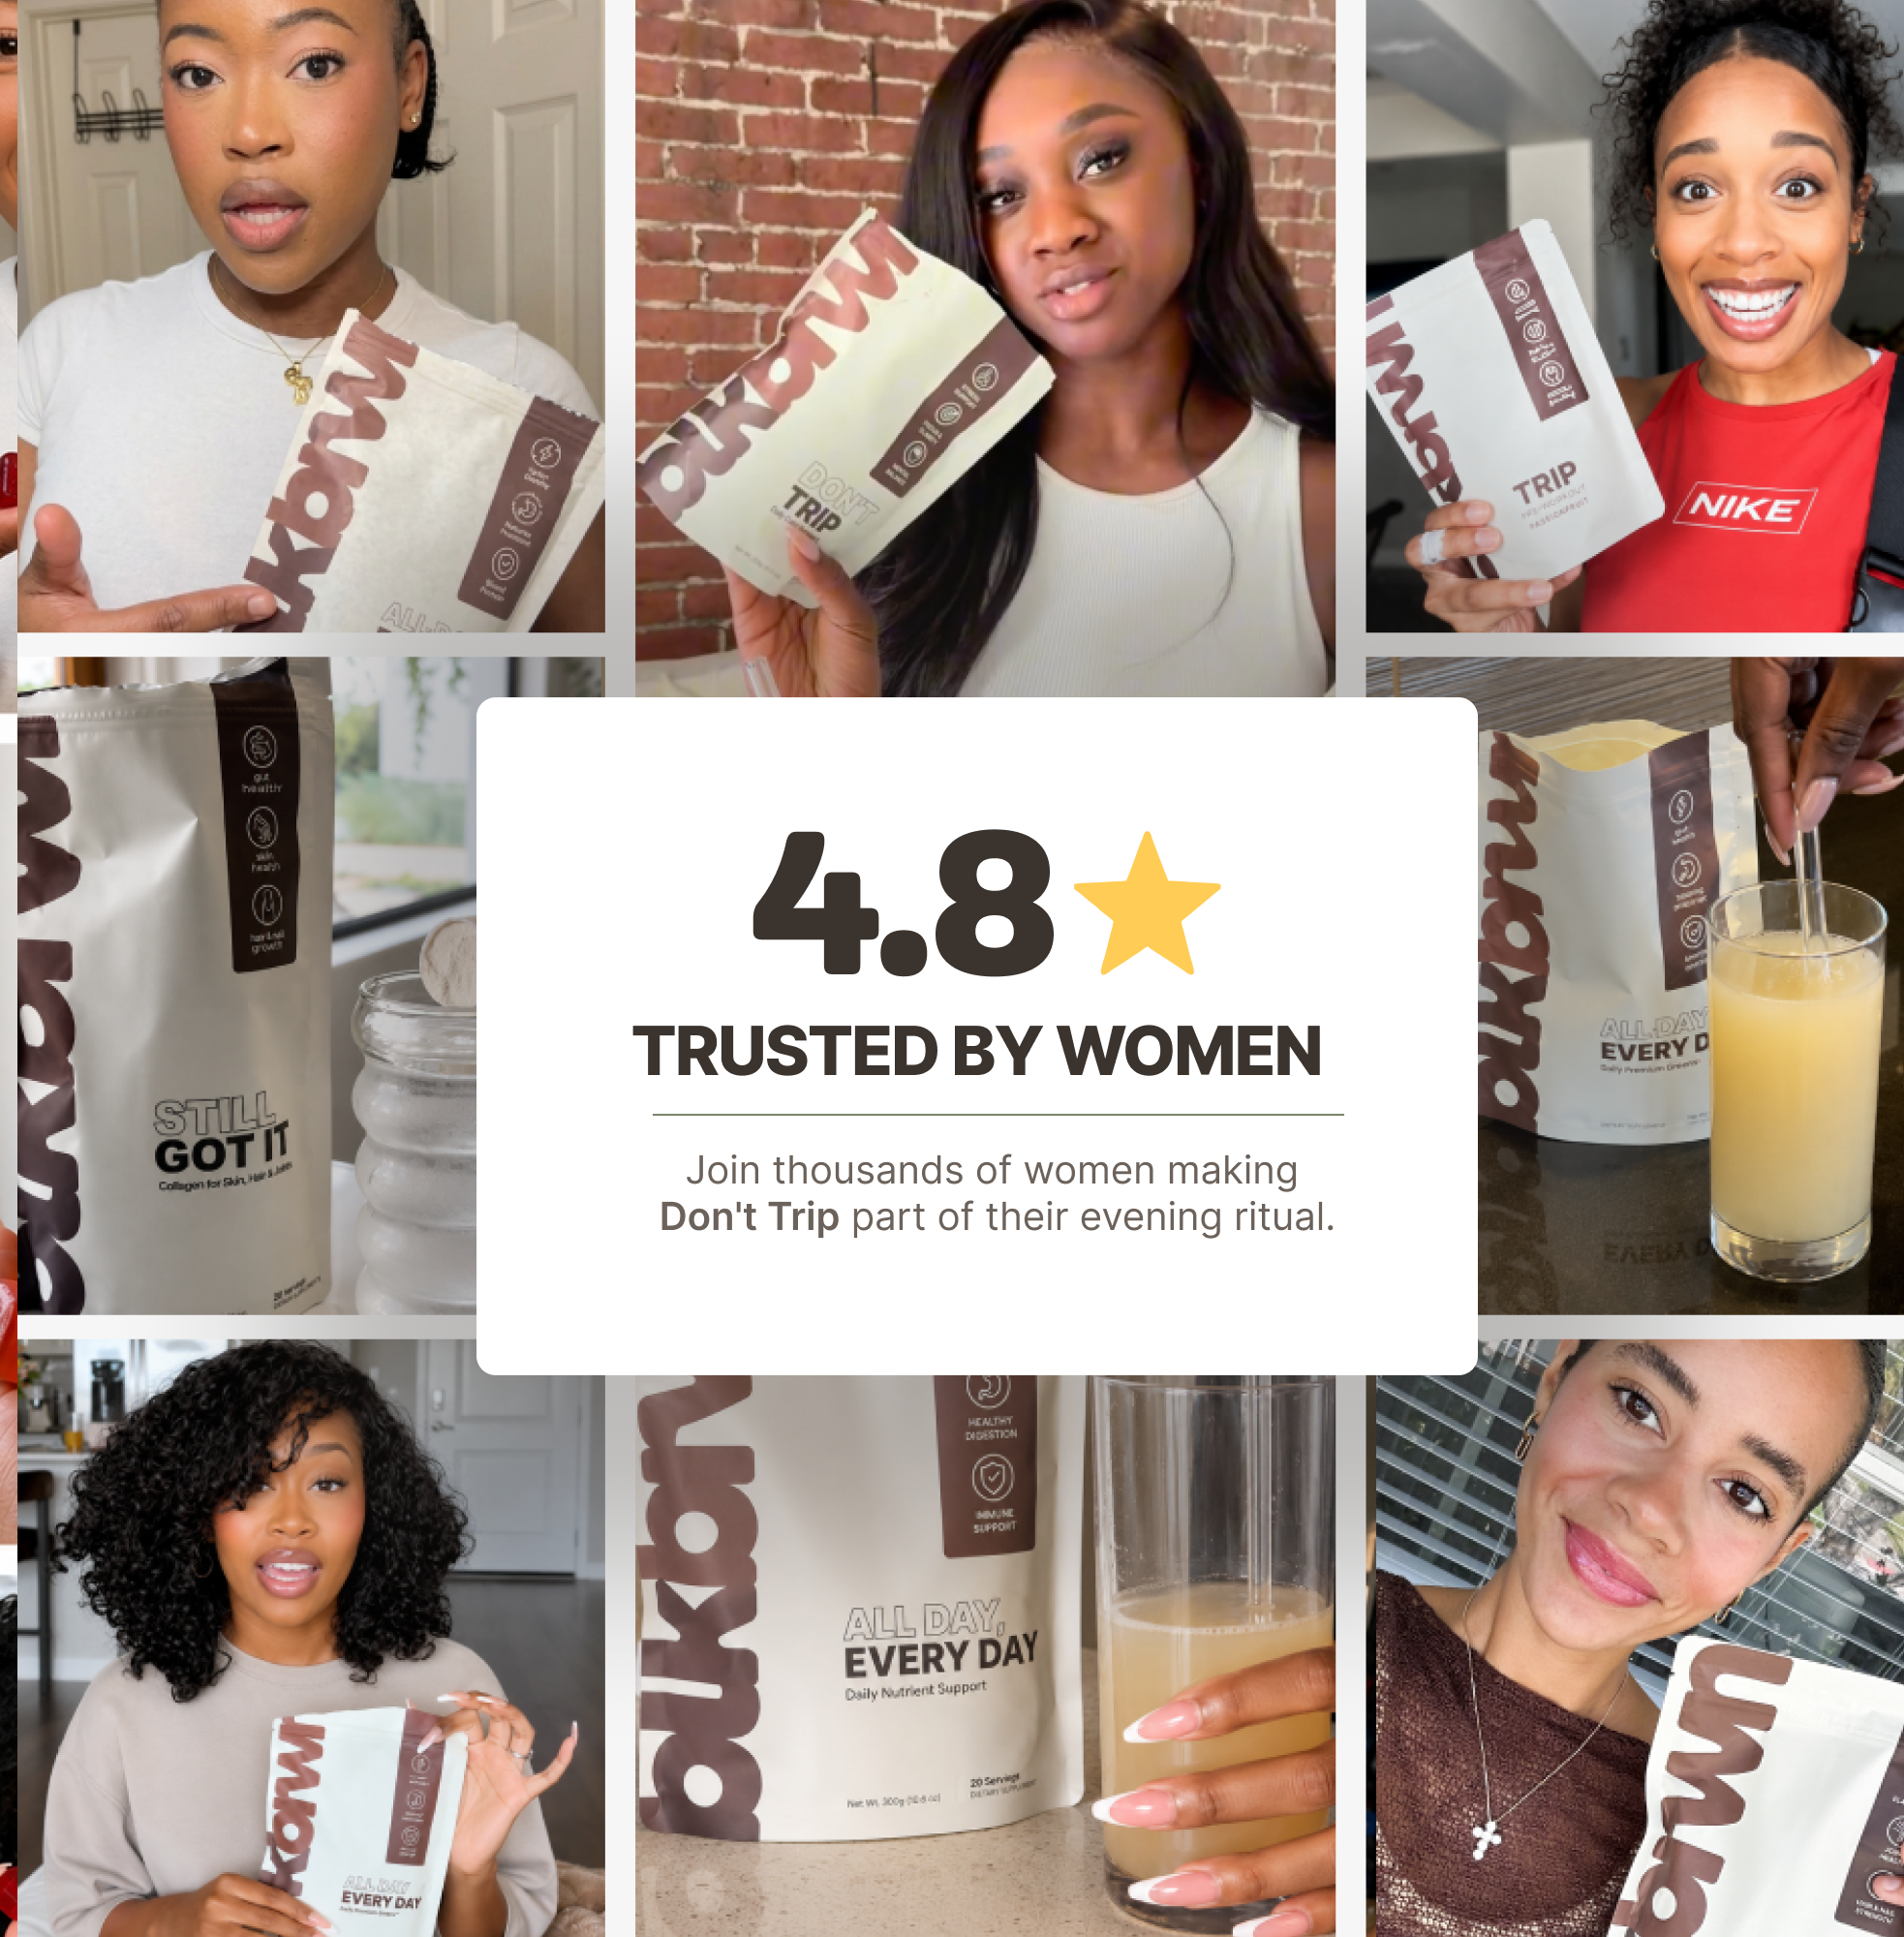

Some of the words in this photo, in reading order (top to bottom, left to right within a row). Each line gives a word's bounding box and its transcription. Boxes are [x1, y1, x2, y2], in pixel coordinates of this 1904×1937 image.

[1512, 460, 1577, 505] TRIP
[783, 484, 843, 532] TRIP
[1689, 492, 1801, 522] NIKE
[242, 783, 283, 793] health
[1600, 1035, 1689, 1061] EVERY
[153, 1091, 277, 1136] STILL
[155, 1132, 256, 1175] GOT
[262, 1118, 290, 1163] IT
[158, 1180, 204, 1192] Collagen
[206, 1179, 221, 1188] for
[968, 1414, 1014, 1428] HEALTHY
[965, 1428, 1018, 1441] DIGESTION
[975, 1508, 1015, 1520] IMMUNE
[973, 1521, 1017, 1534] SUPPORT
[843, 1604, 917, 1643] ALL
[922, 1597, 1006, 1639] DAY,
[845, 1639, 971, 1679] EVERY
[977, 1629, 1039, 1670] DAY
[845, 1687, 878, 1703] Daily
[880, 1683, 935, 1700] Nutrient
[937, 1679, 988, 1696] Support
[342, 1890, 393, 1909] EVERY
[395, 1895, 422, 1910] DAY
